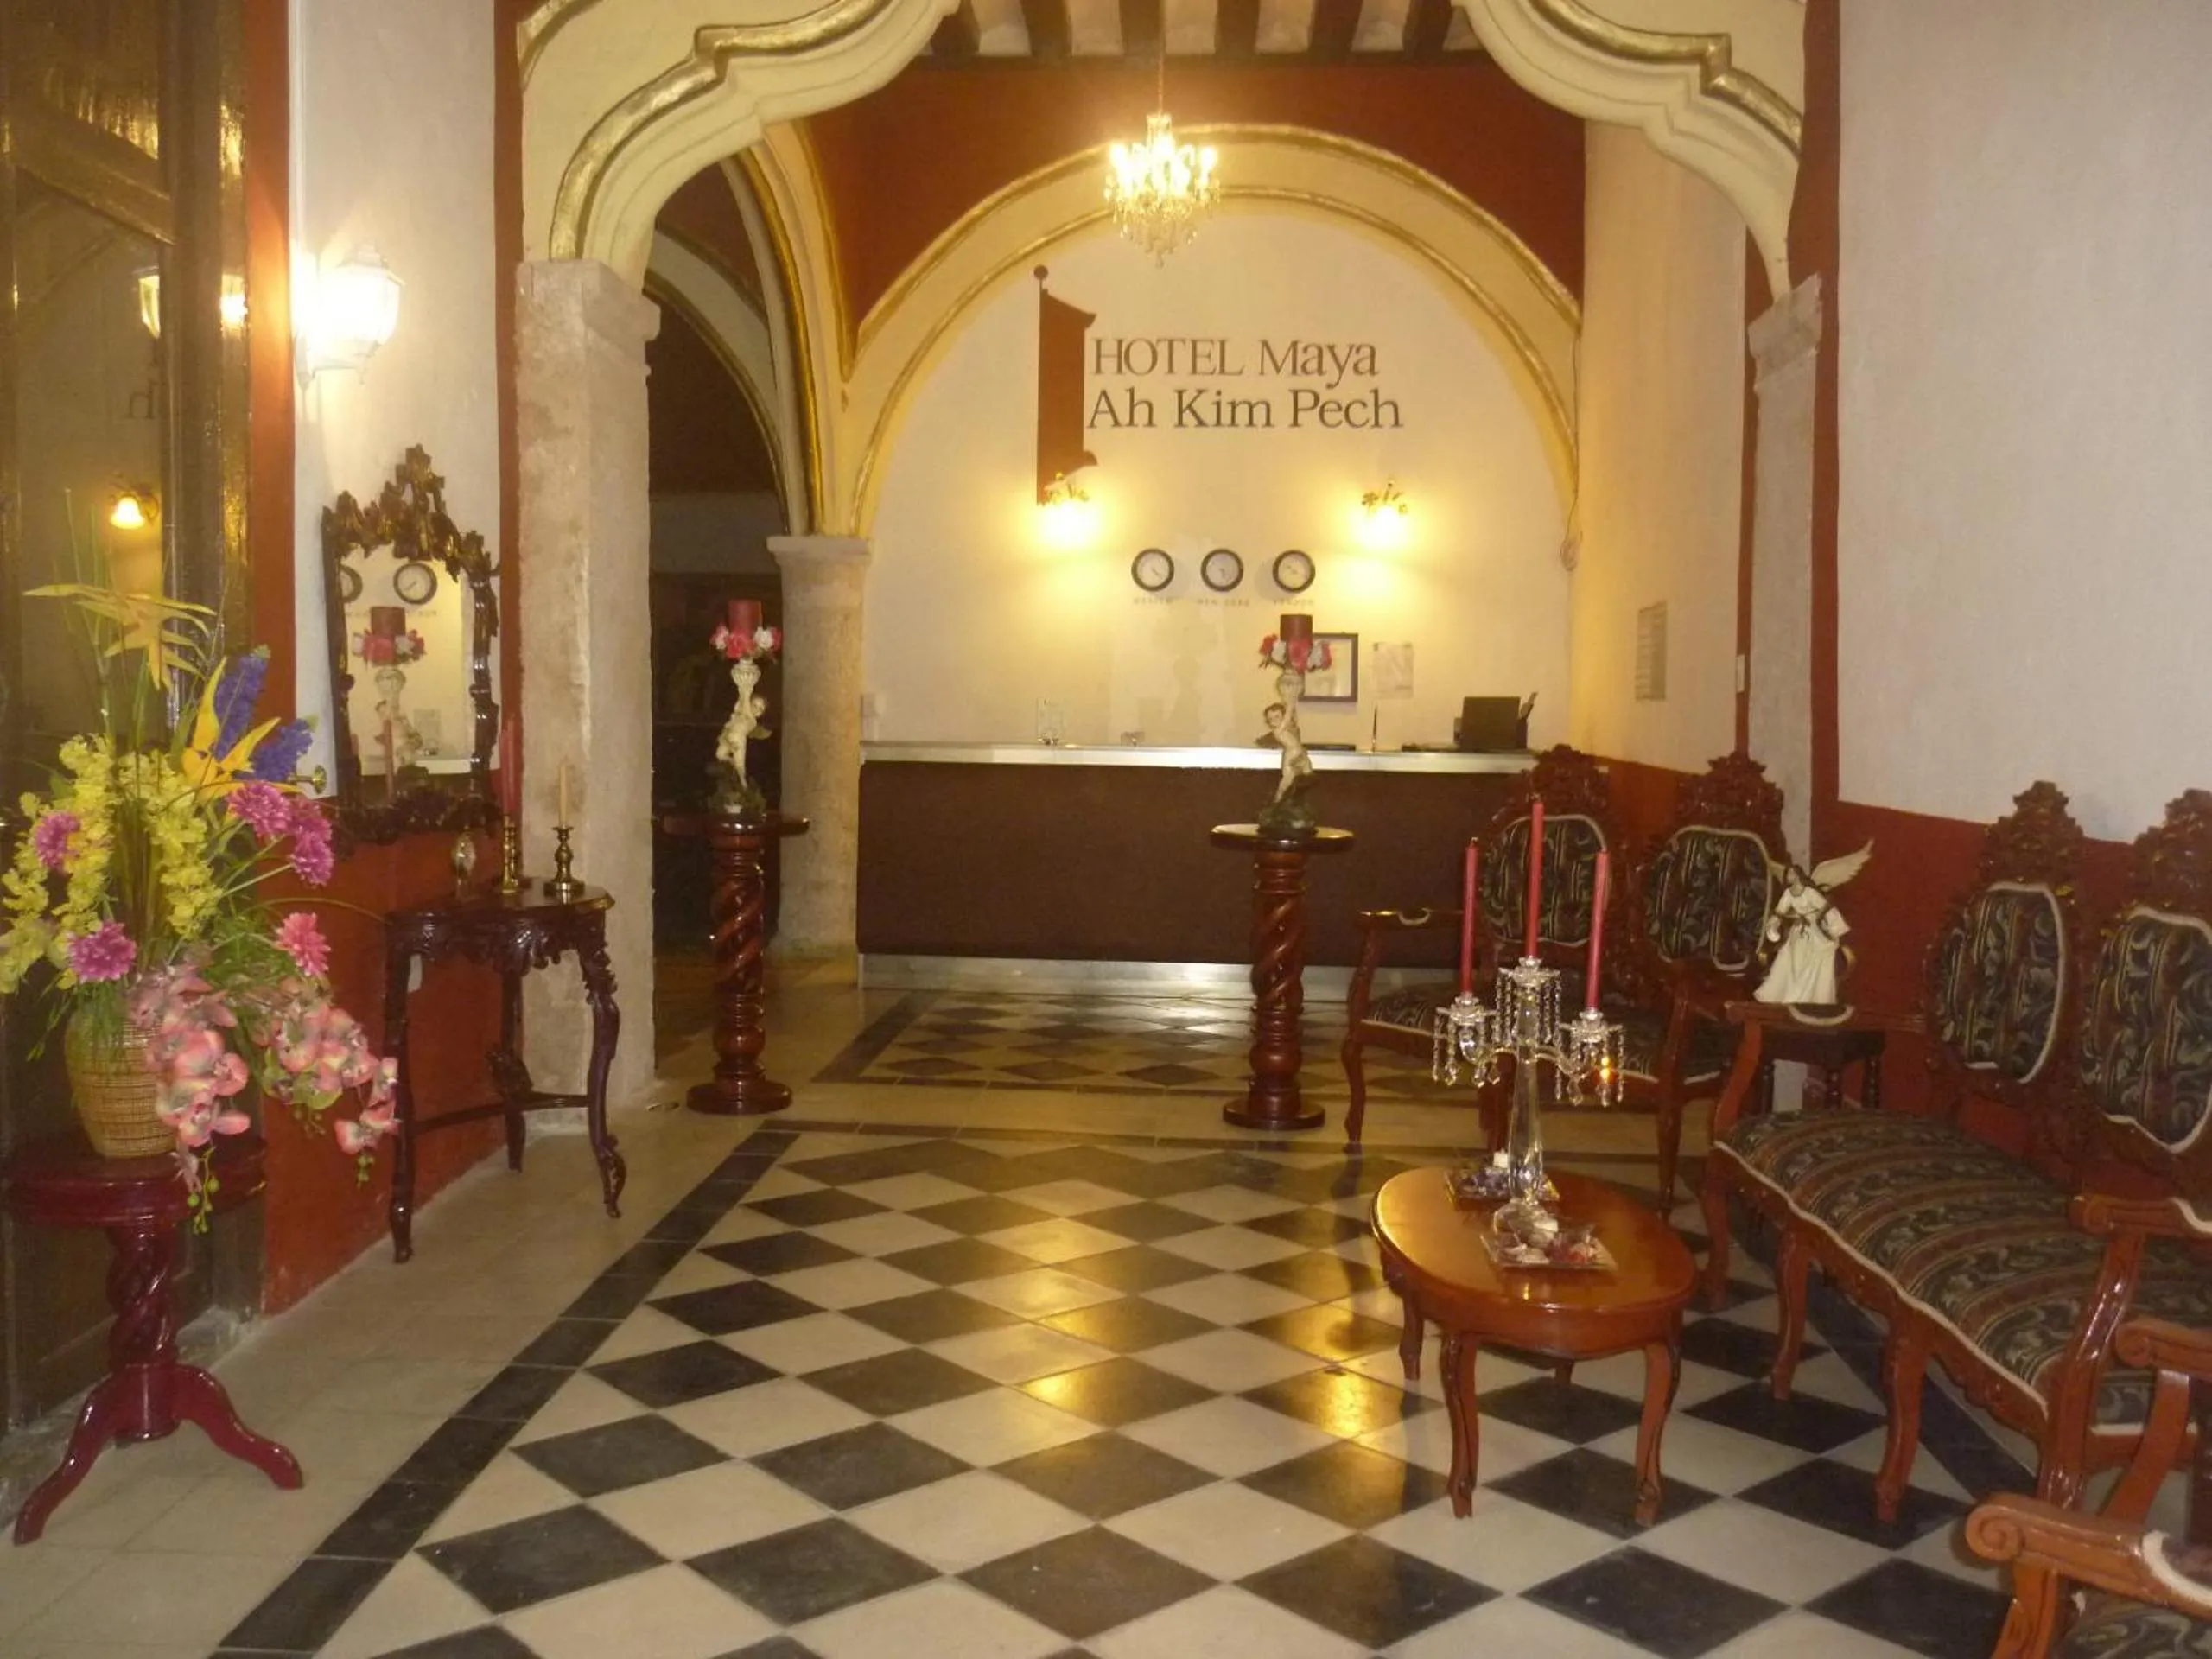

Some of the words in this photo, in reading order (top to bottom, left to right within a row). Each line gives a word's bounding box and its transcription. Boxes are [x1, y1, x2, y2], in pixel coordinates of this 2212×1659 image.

[1094, 338, 1245, 377] HOTEL
[1258, 338, 1380, 389] Maya
[1088, 385, 1158, 429] Ah
[1173, 388, 1275, 429] Kim
[1287, 386, 1405, 430] Pech
